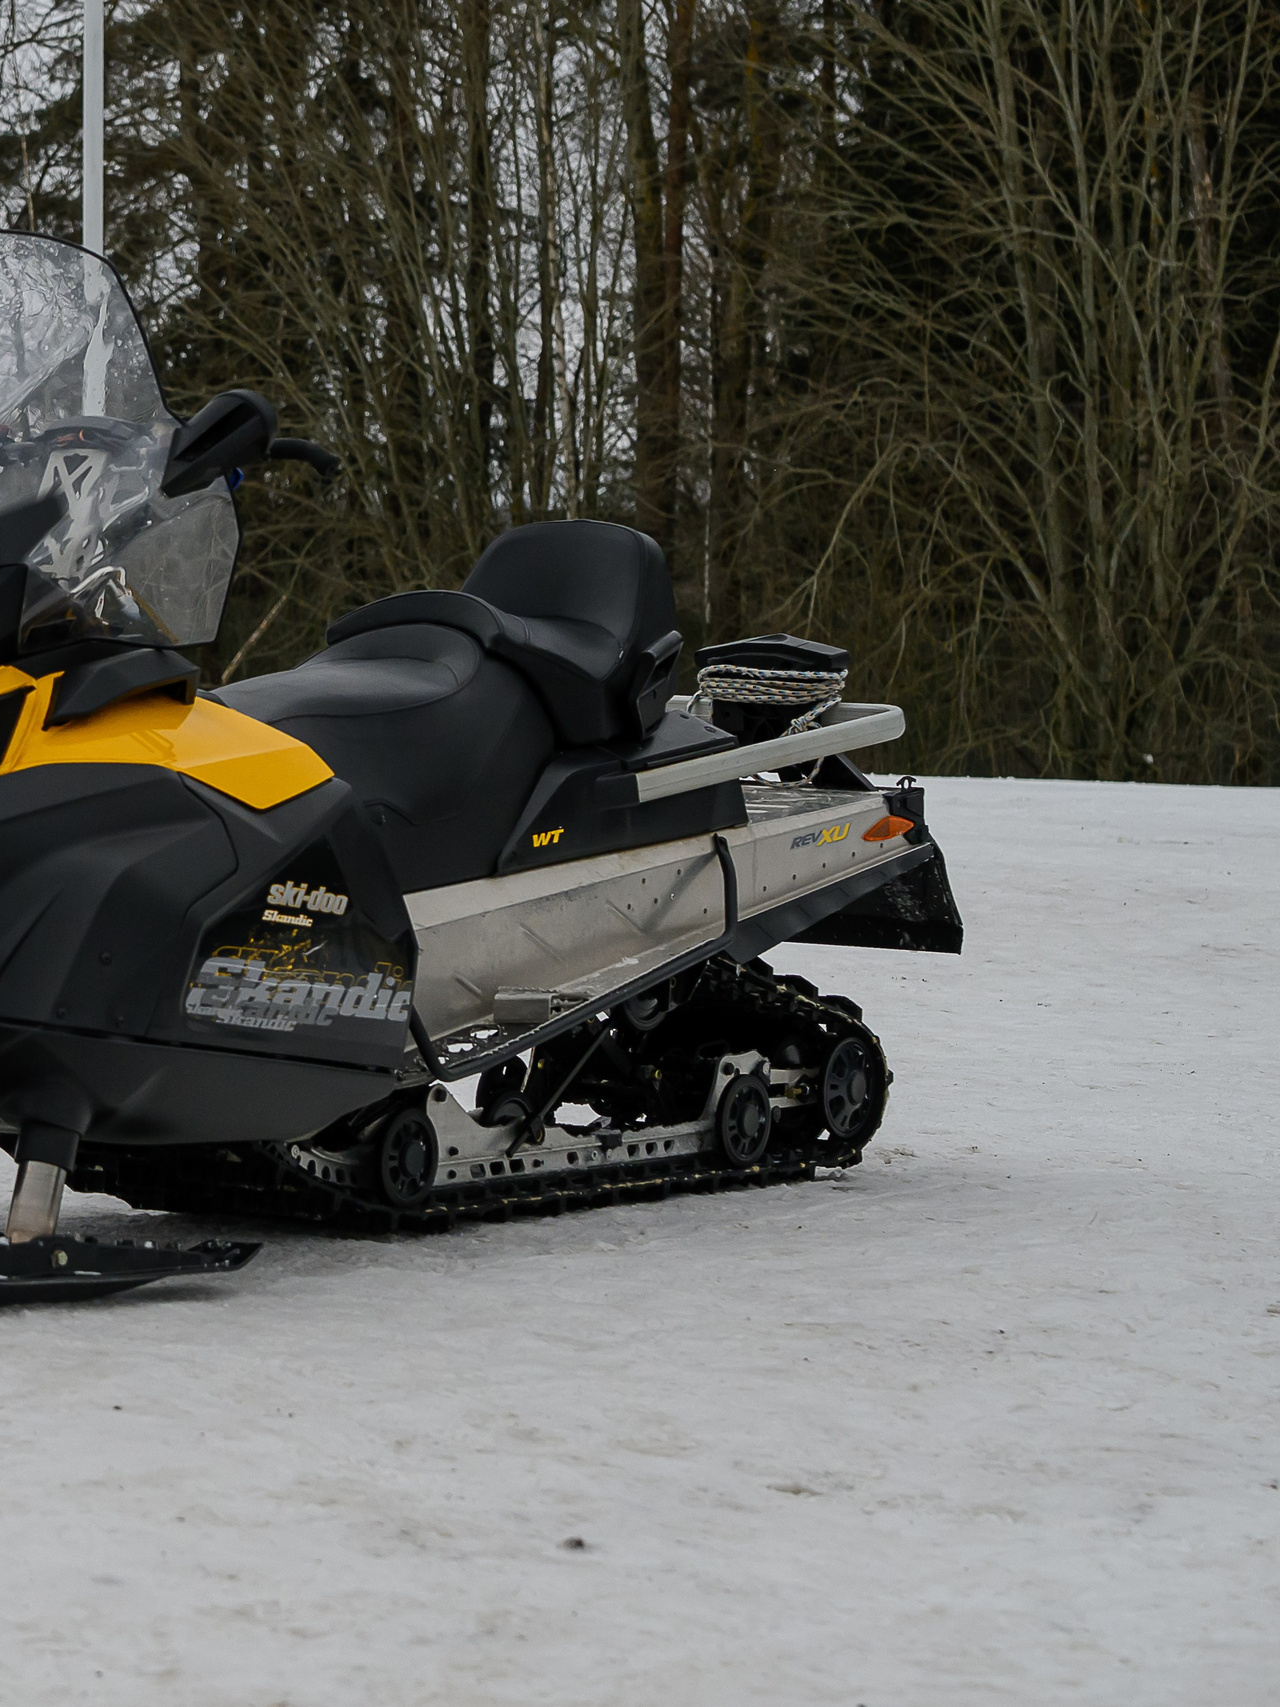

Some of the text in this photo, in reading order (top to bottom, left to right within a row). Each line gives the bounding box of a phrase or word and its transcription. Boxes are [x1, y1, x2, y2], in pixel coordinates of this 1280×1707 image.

[532, 828, 564, 848] WT
[267, 881, 348, 915] ski-doo
[262, 909, 313, 927] Skandic
